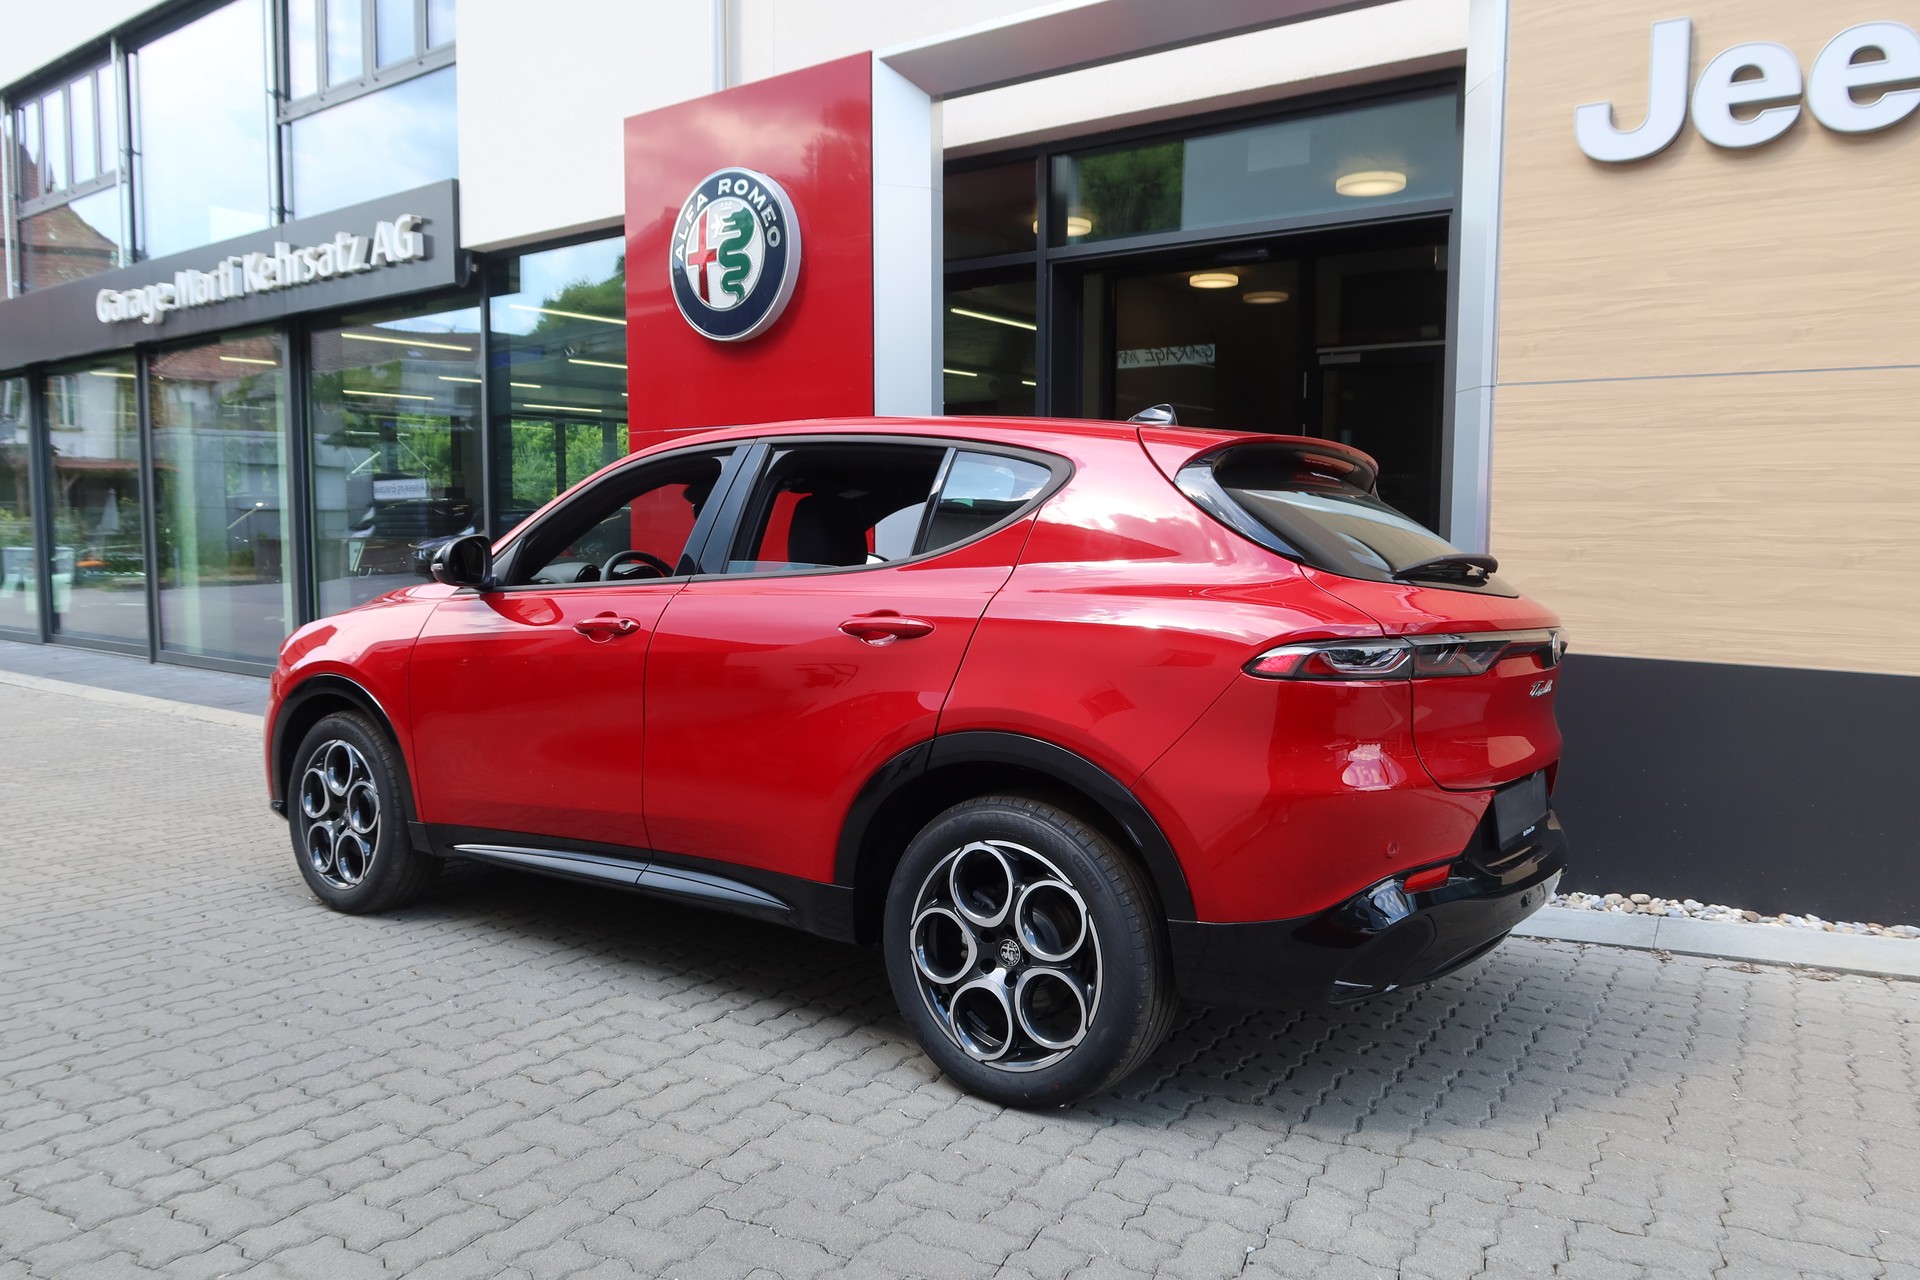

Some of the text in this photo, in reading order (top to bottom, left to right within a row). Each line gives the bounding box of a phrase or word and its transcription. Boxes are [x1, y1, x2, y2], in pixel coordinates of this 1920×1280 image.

[1574, 16, 1920, 163] Jee
[96, 213, 424, 324] Garage Marti Kehrsatz AG
[675, 178, 780, 261] ALFA ROMEO
